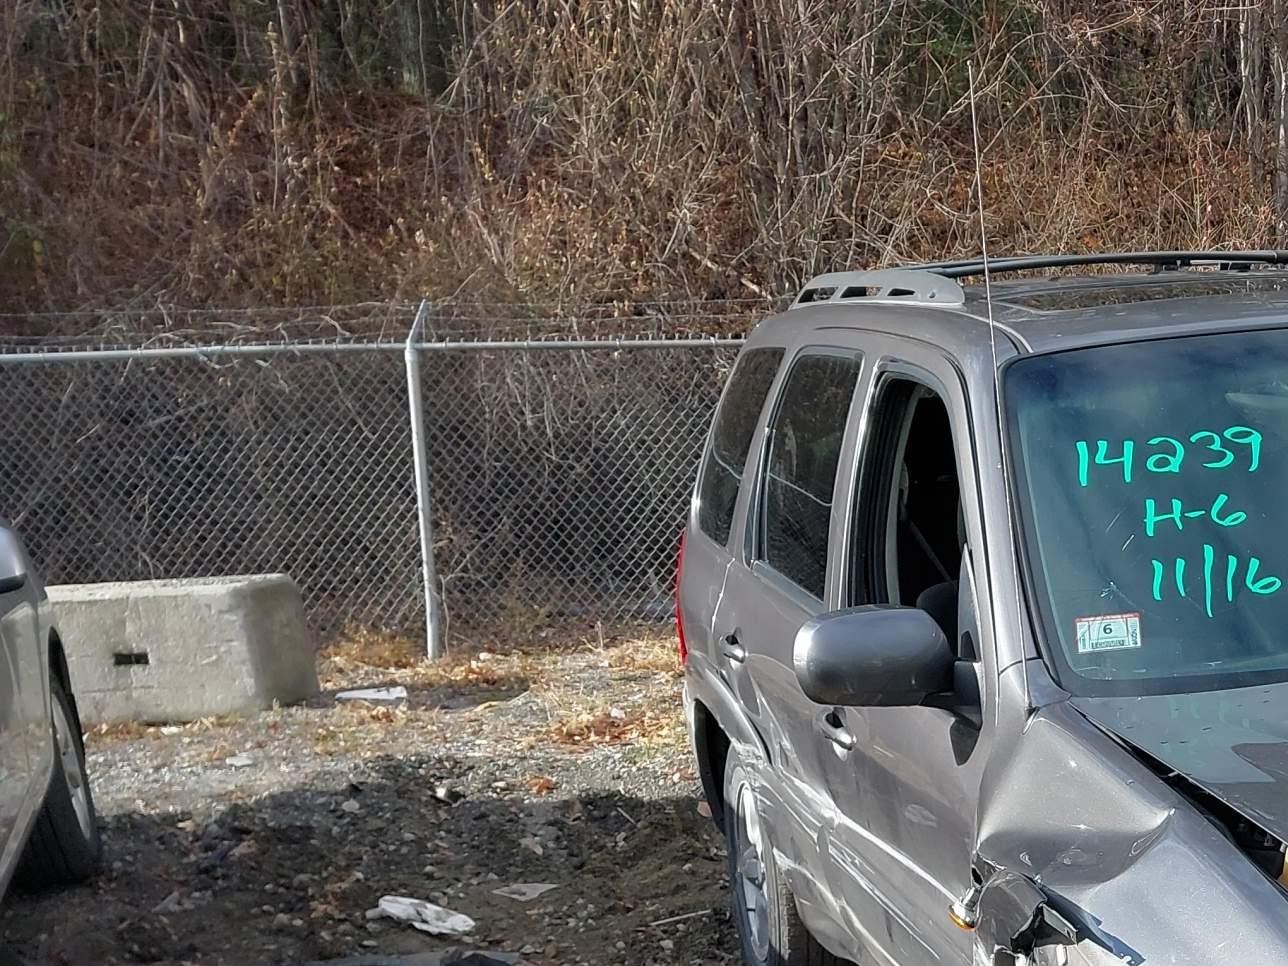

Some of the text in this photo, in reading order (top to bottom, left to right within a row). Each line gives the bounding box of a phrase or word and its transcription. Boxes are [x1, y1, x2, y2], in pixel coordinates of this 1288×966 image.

[1143, 493, 1248, 538] H-6
[1152, 543, 1283, 617] 11/16
[1102, 623, 1113, 635] 6
